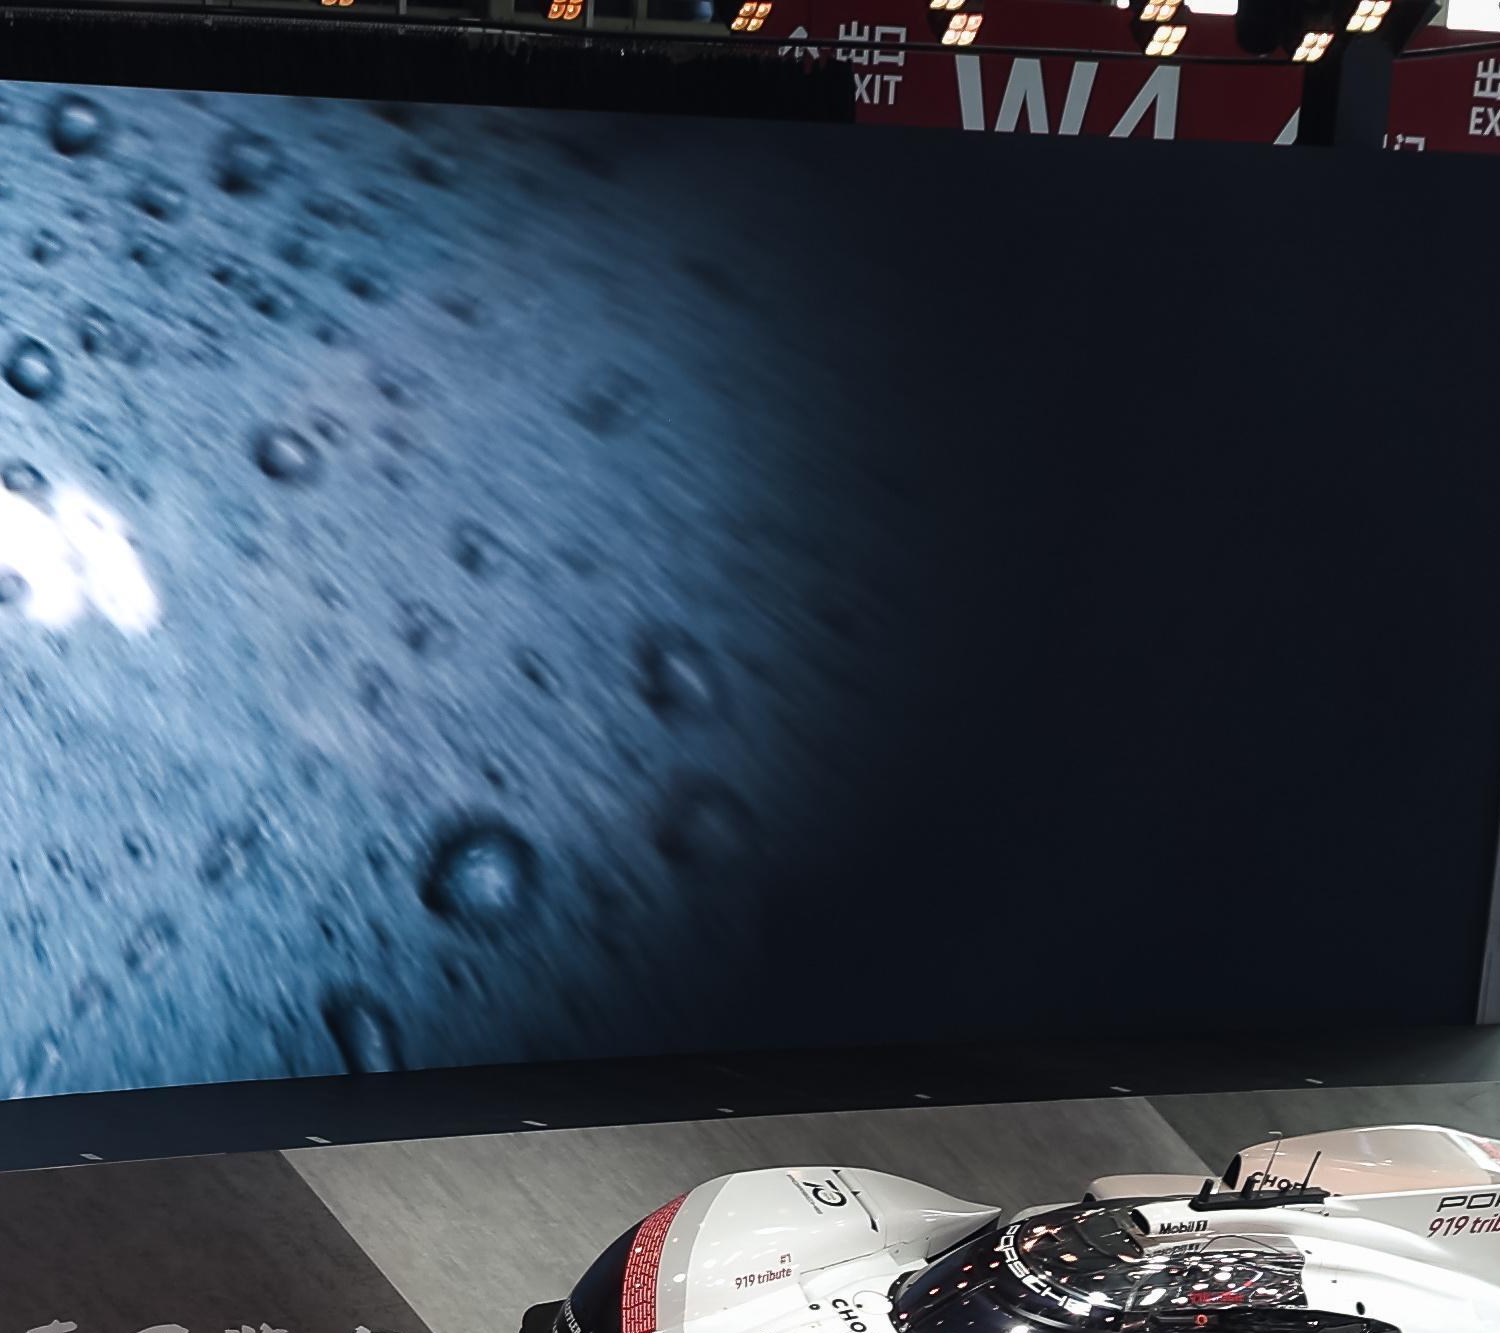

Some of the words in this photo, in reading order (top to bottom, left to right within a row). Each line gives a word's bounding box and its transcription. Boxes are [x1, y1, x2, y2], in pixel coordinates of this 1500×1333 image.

[835, 21, 907, 67] 出口
[851, 73, 904, 106] XIT
[1159, 1222, 1195, 1235] Mobil
[1427, 1215, 1469, 1238] 919
[735, 1274, 756, 1290] 919
[757, 1267, 792, 1285] tribute
[999, 1223, 1094, 1317] PORSCHE
